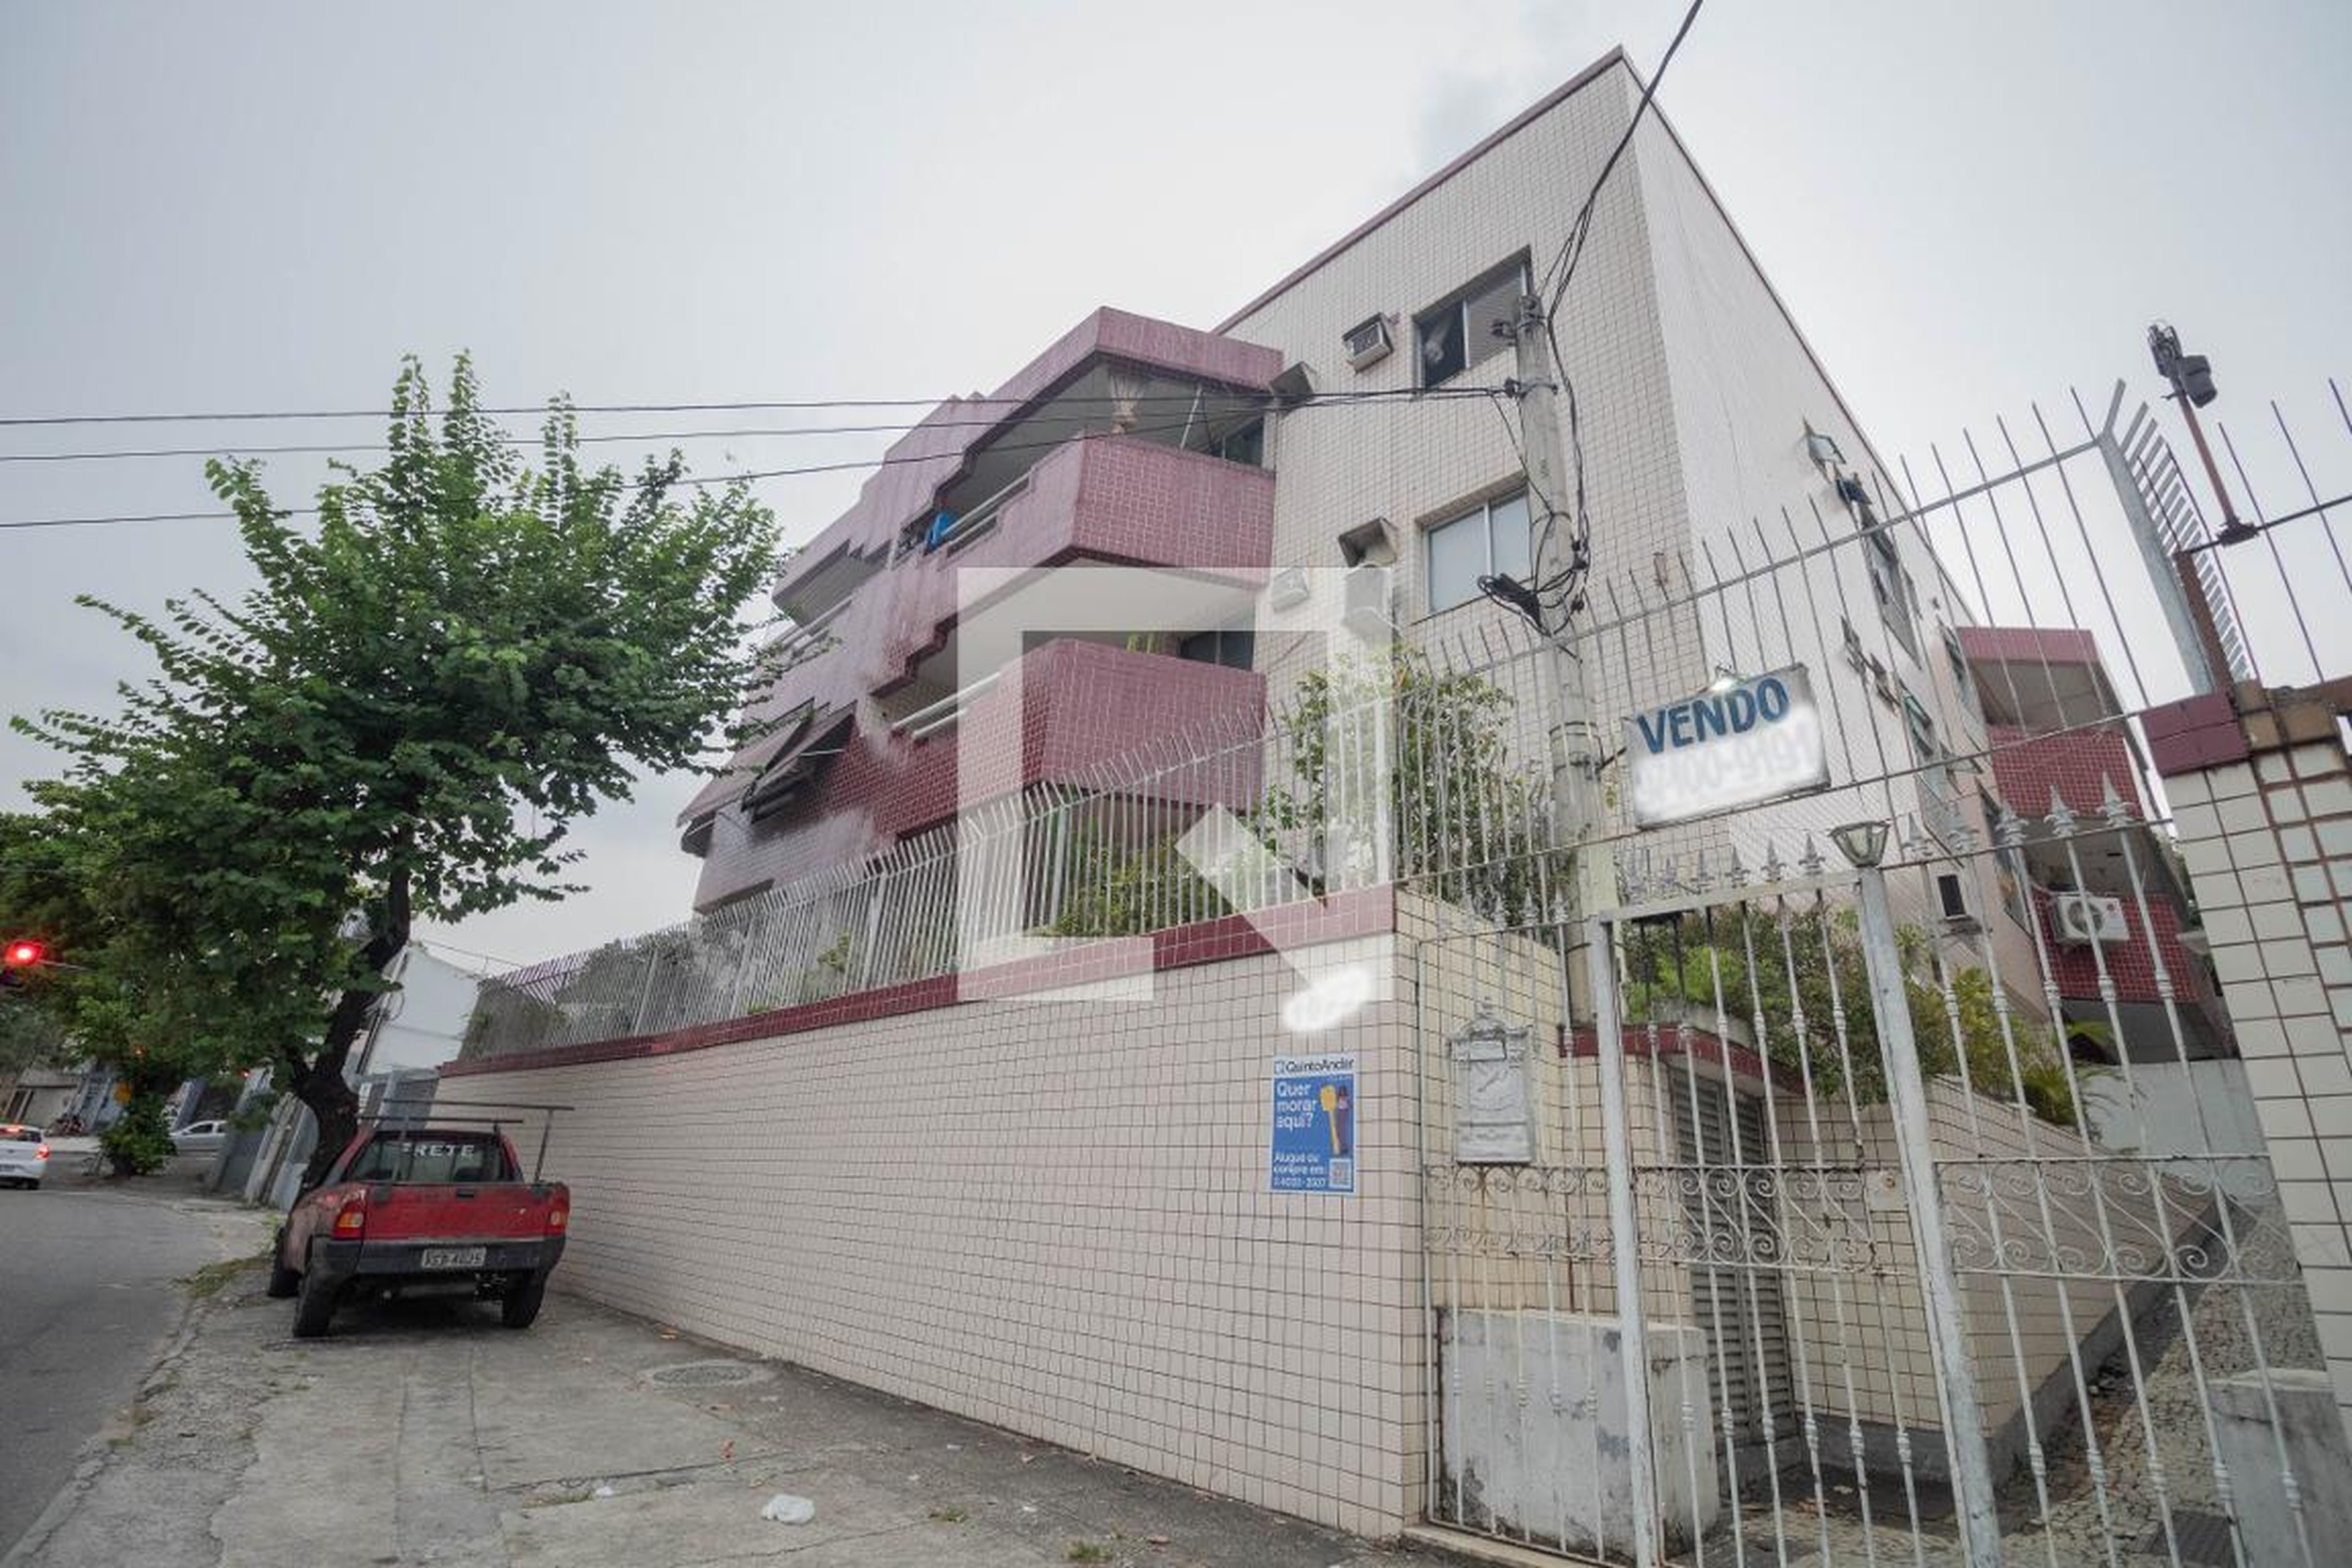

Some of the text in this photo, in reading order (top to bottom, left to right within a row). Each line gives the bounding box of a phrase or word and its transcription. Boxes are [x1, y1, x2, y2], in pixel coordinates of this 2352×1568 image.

[1637, 677, 1790, 755] VENDO
[1277, 1082, 1311, 1097] Quer
[1276, 1099, 1317, 1112] morar
[1276, 1112, 1313, 1132] aqui?
